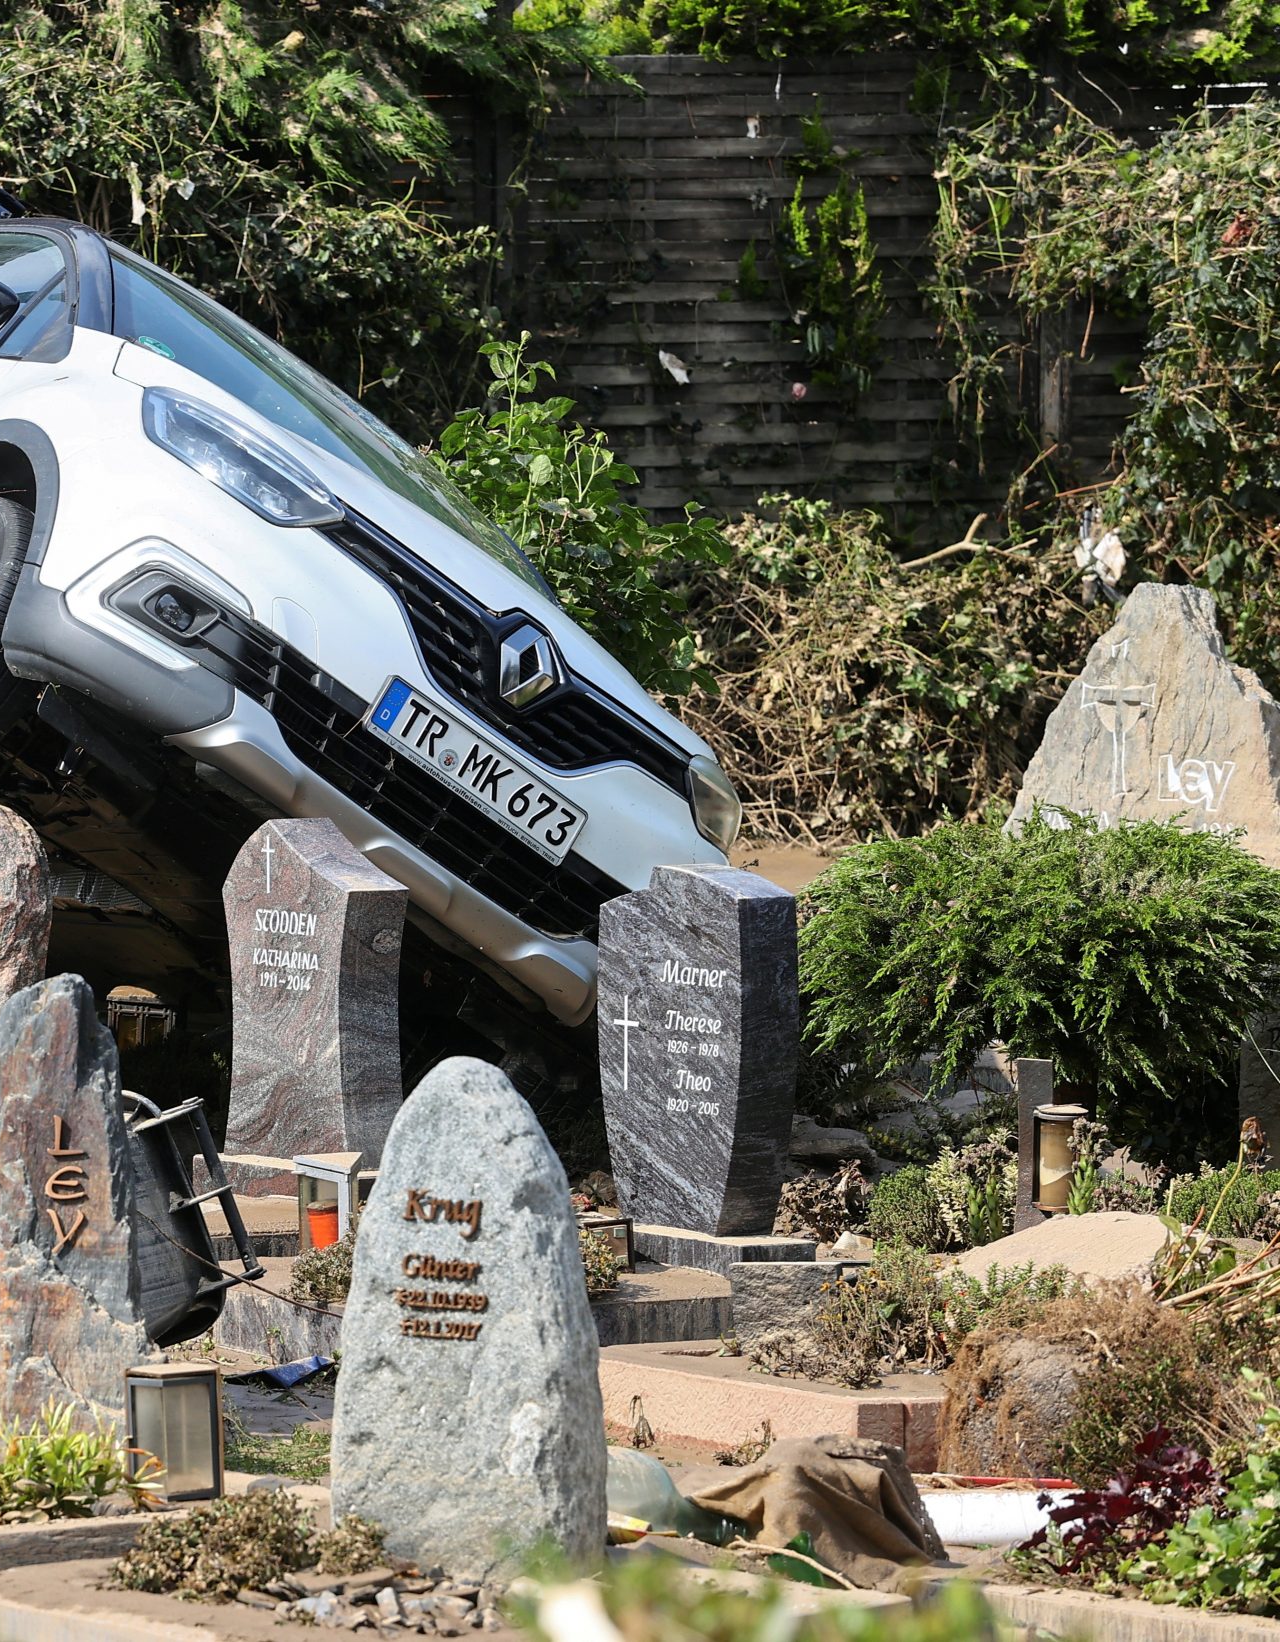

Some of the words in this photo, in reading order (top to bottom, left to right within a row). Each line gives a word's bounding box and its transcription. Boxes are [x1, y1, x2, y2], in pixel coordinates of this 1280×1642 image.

[380, 709, 391, 721] D
[400, 699, 449, 758] TR
[458, 743, 514, 803] MK
[508, 782, 577, 846] 673
[407, 752, 491, 815] www.autohaus-raiffeisen.de
[254, 908, 318, 936] STODDEN
[252, 947, 319, 971] KATHARINA
[659, 959, 727, 989] Marner
[664, 1009, 722, 1035] Therese
[667, 1040, 688, 1055] 1926
[699, 1043, 720, 1058] 1978
[675, 1068, 712, 1092] Theo
[667, 1098, 689, 1113] 1920
[698, 1102, 720, 1117] 2015
[402, 1188, 483, 1240] Krug
